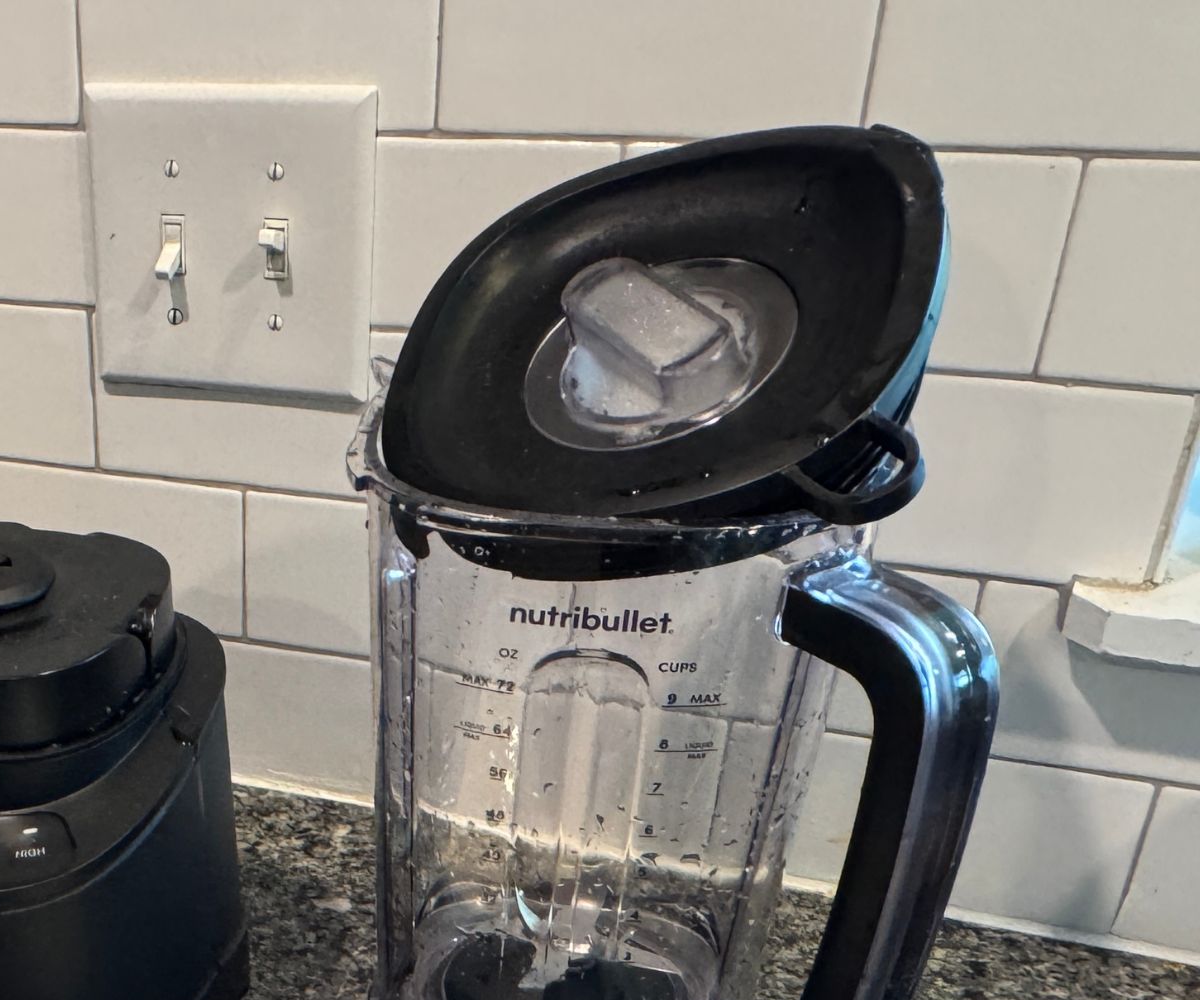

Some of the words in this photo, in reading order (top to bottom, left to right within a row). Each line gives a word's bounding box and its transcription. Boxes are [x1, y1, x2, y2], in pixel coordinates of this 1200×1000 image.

[498, 648, 518, 659] OZ
[658, 662, 697, 673] CUPS
[667, 693, 677, 704] 9
[690, 693, 721, 703] MAX
[652, 783, 662, 793] 7
[644, 825, 653, 835] 6
